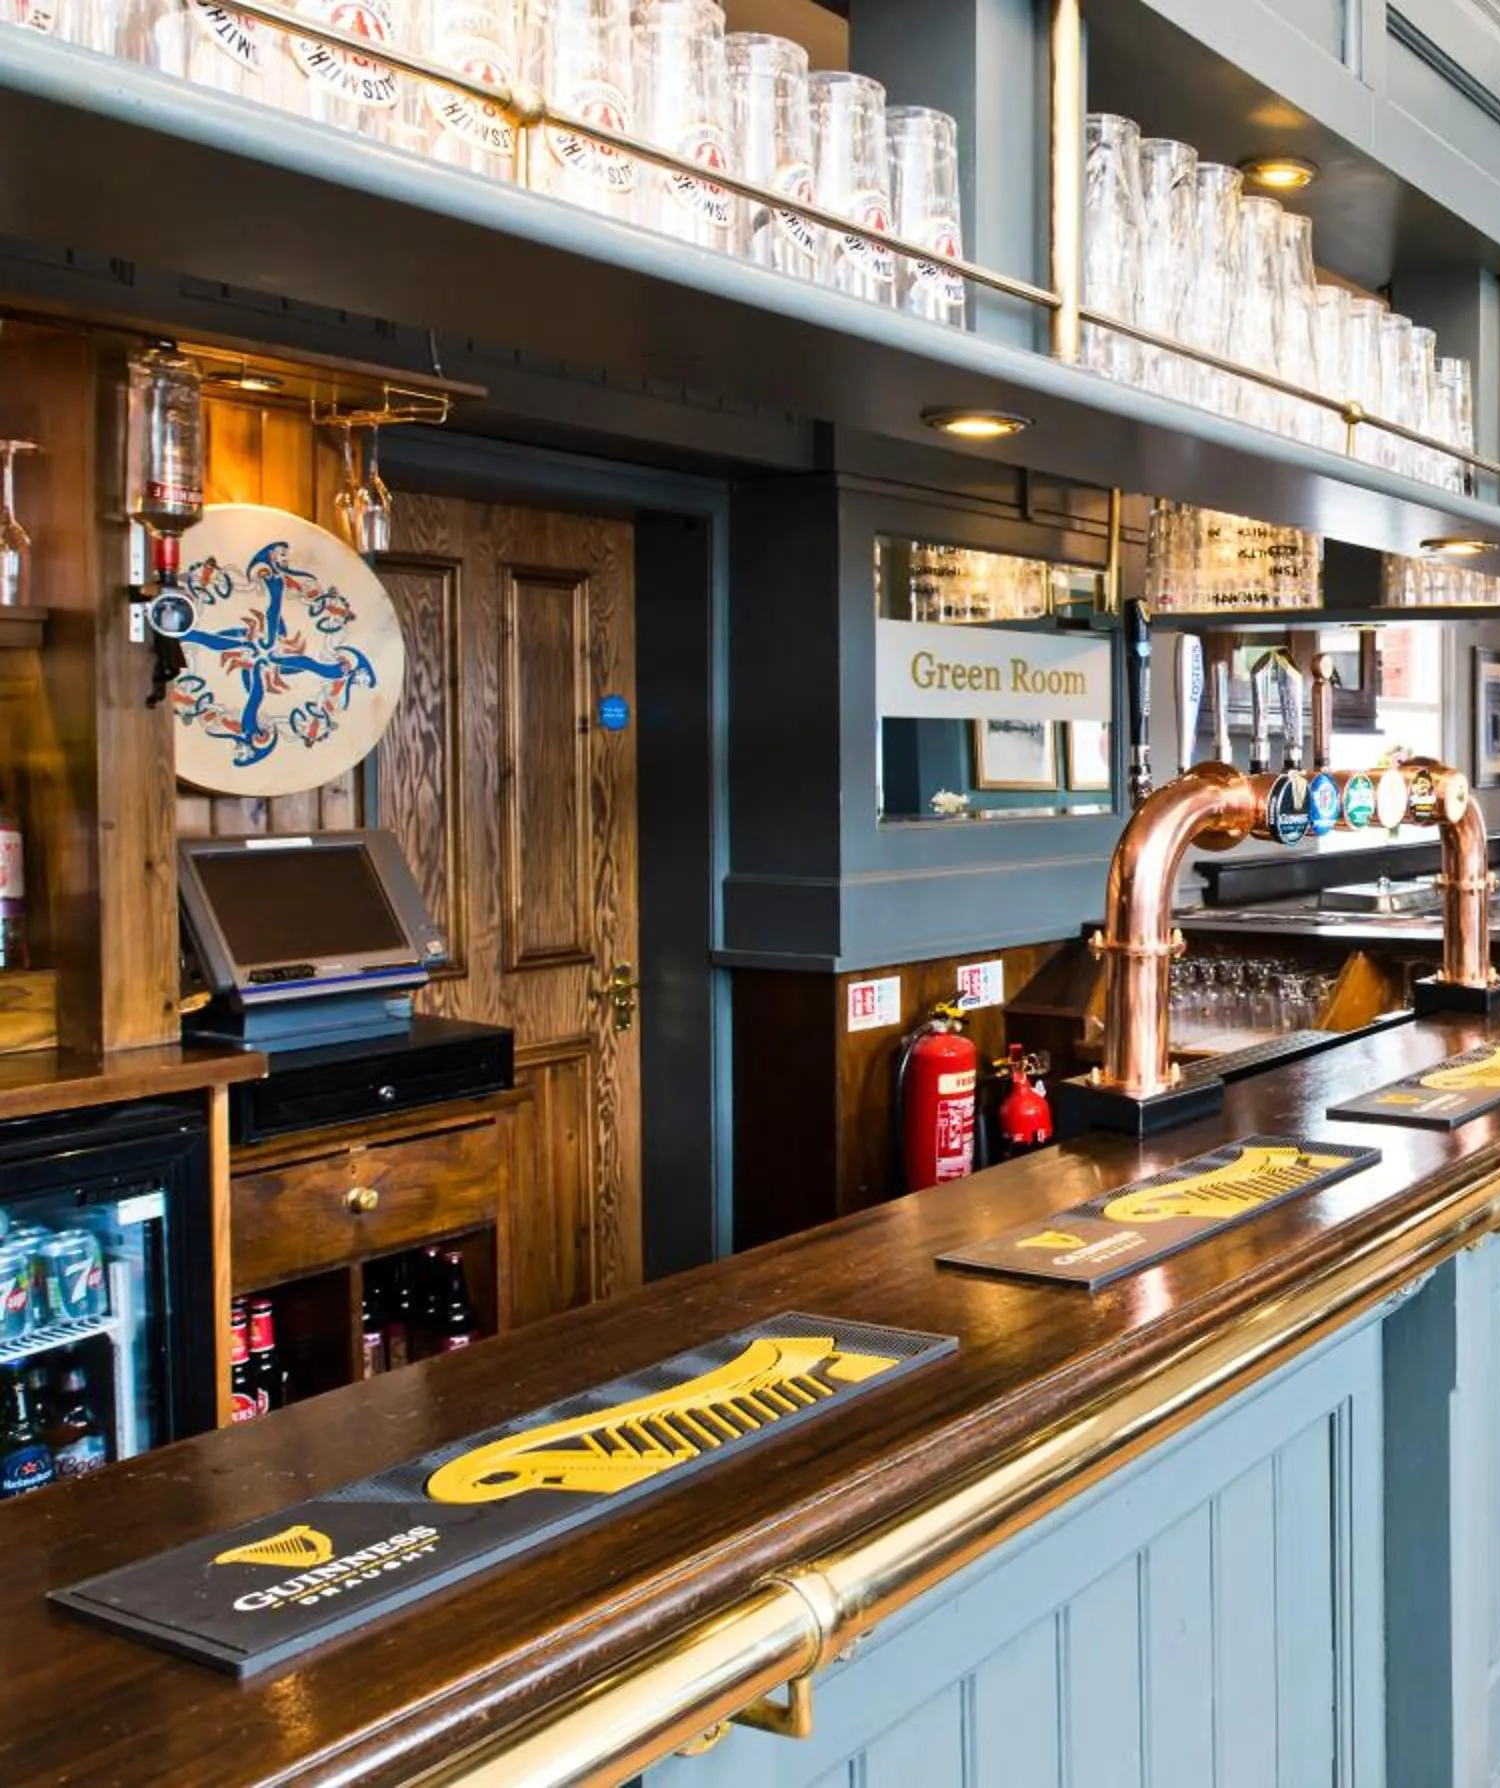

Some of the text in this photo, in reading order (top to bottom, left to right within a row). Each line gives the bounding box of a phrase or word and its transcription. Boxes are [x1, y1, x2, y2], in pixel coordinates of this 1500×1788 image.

[911, 651, 1087, 694] Green Room
[233, 1525, 437, 1611] GUINNESS
[298, 1545, 436, 1605] DRAUGHT
